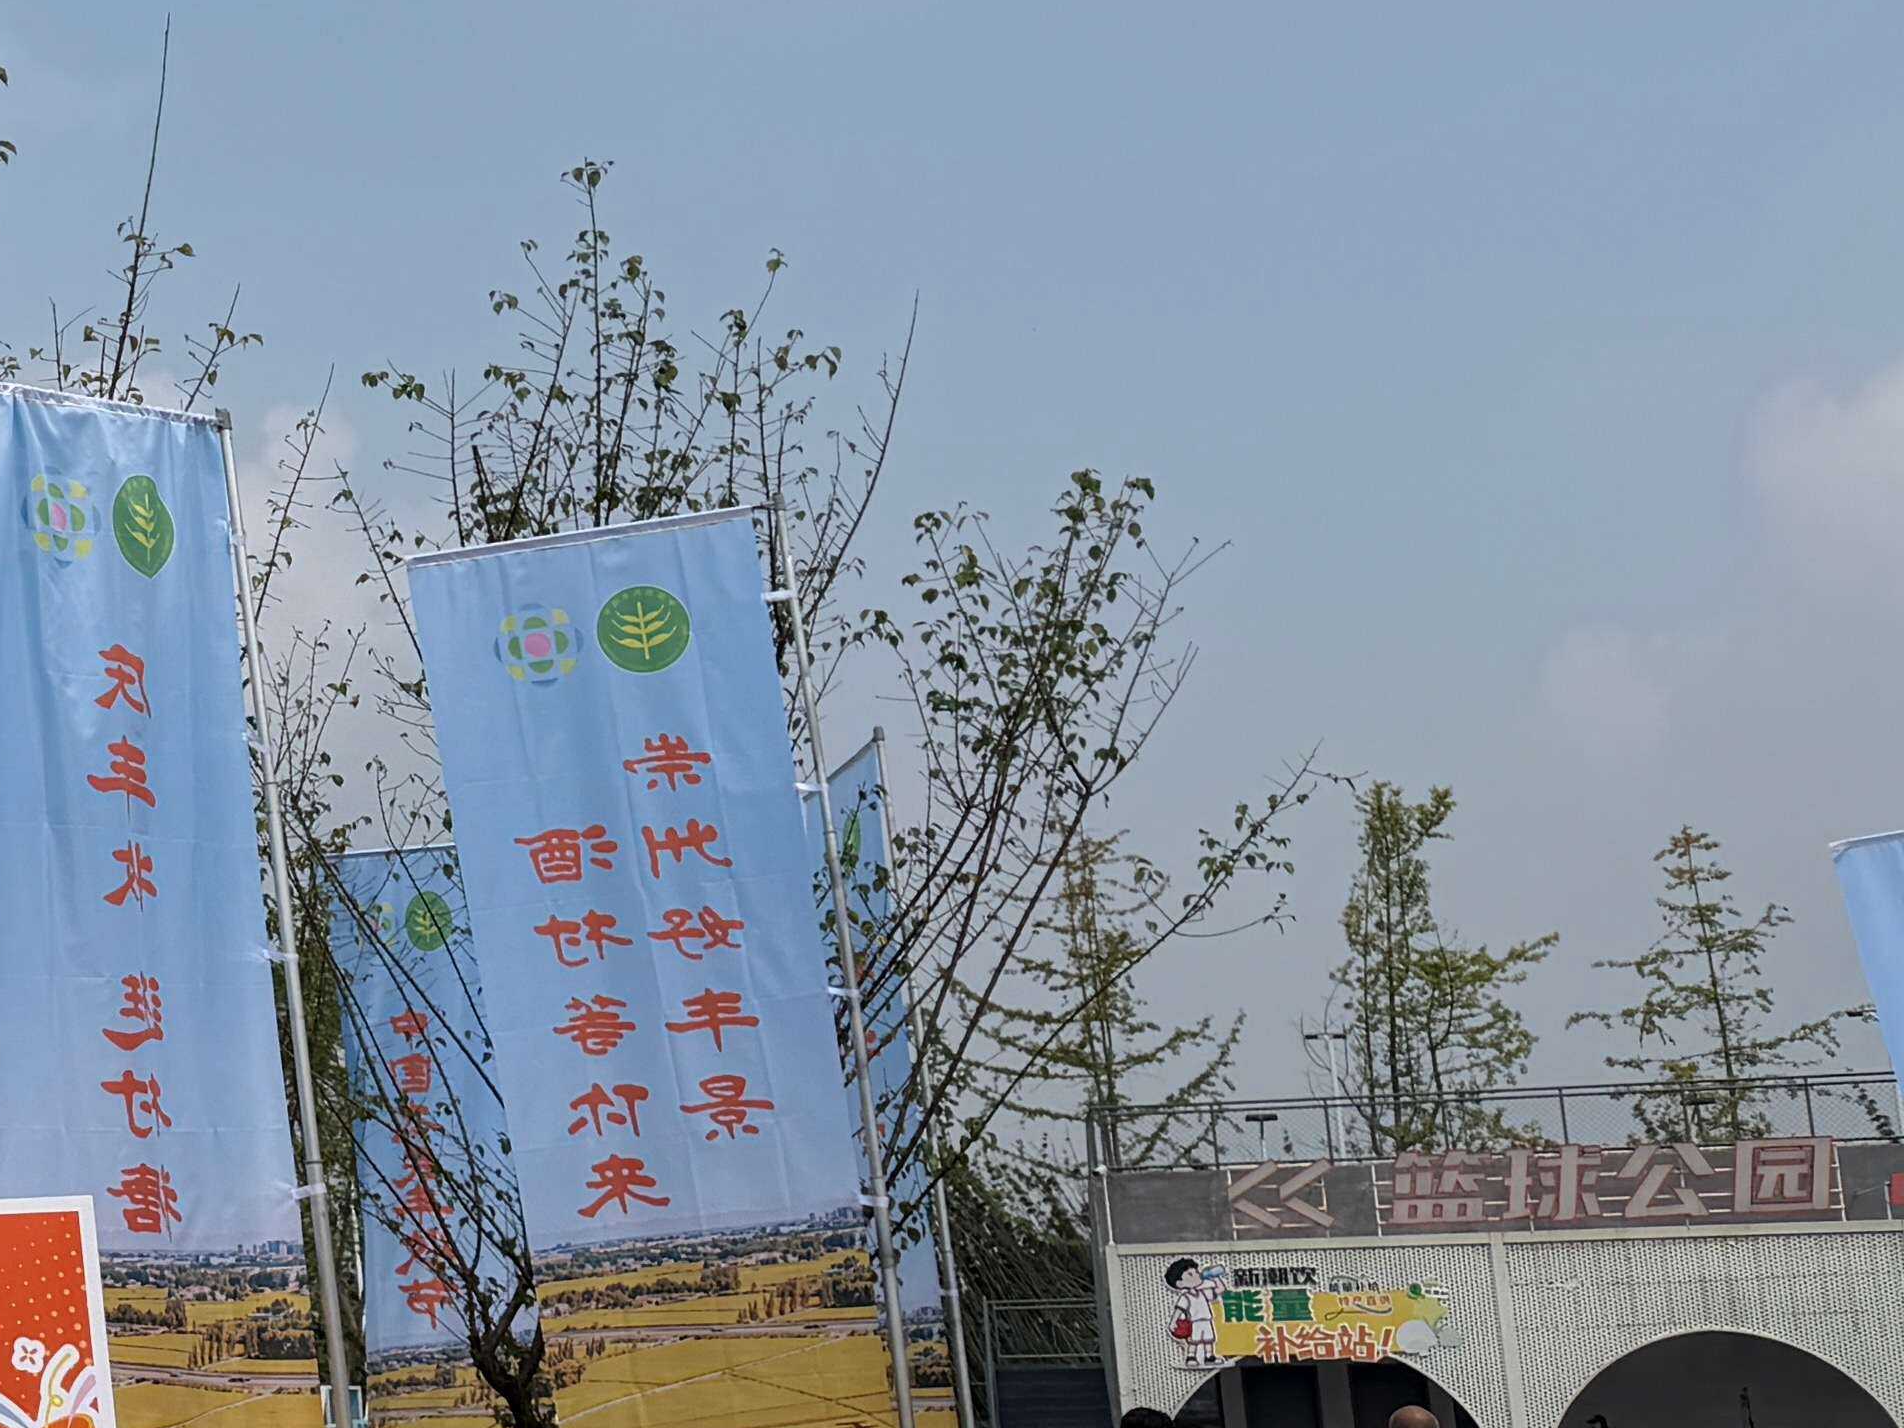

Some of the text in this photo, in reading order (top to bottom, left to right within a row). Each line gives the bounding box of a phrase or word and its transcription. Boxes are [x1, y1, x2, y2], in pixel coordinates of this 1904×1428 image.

[1392, 1137, 1832, 1225] 篮球公园
[1223, 1290, 1313, 1322] 能量
